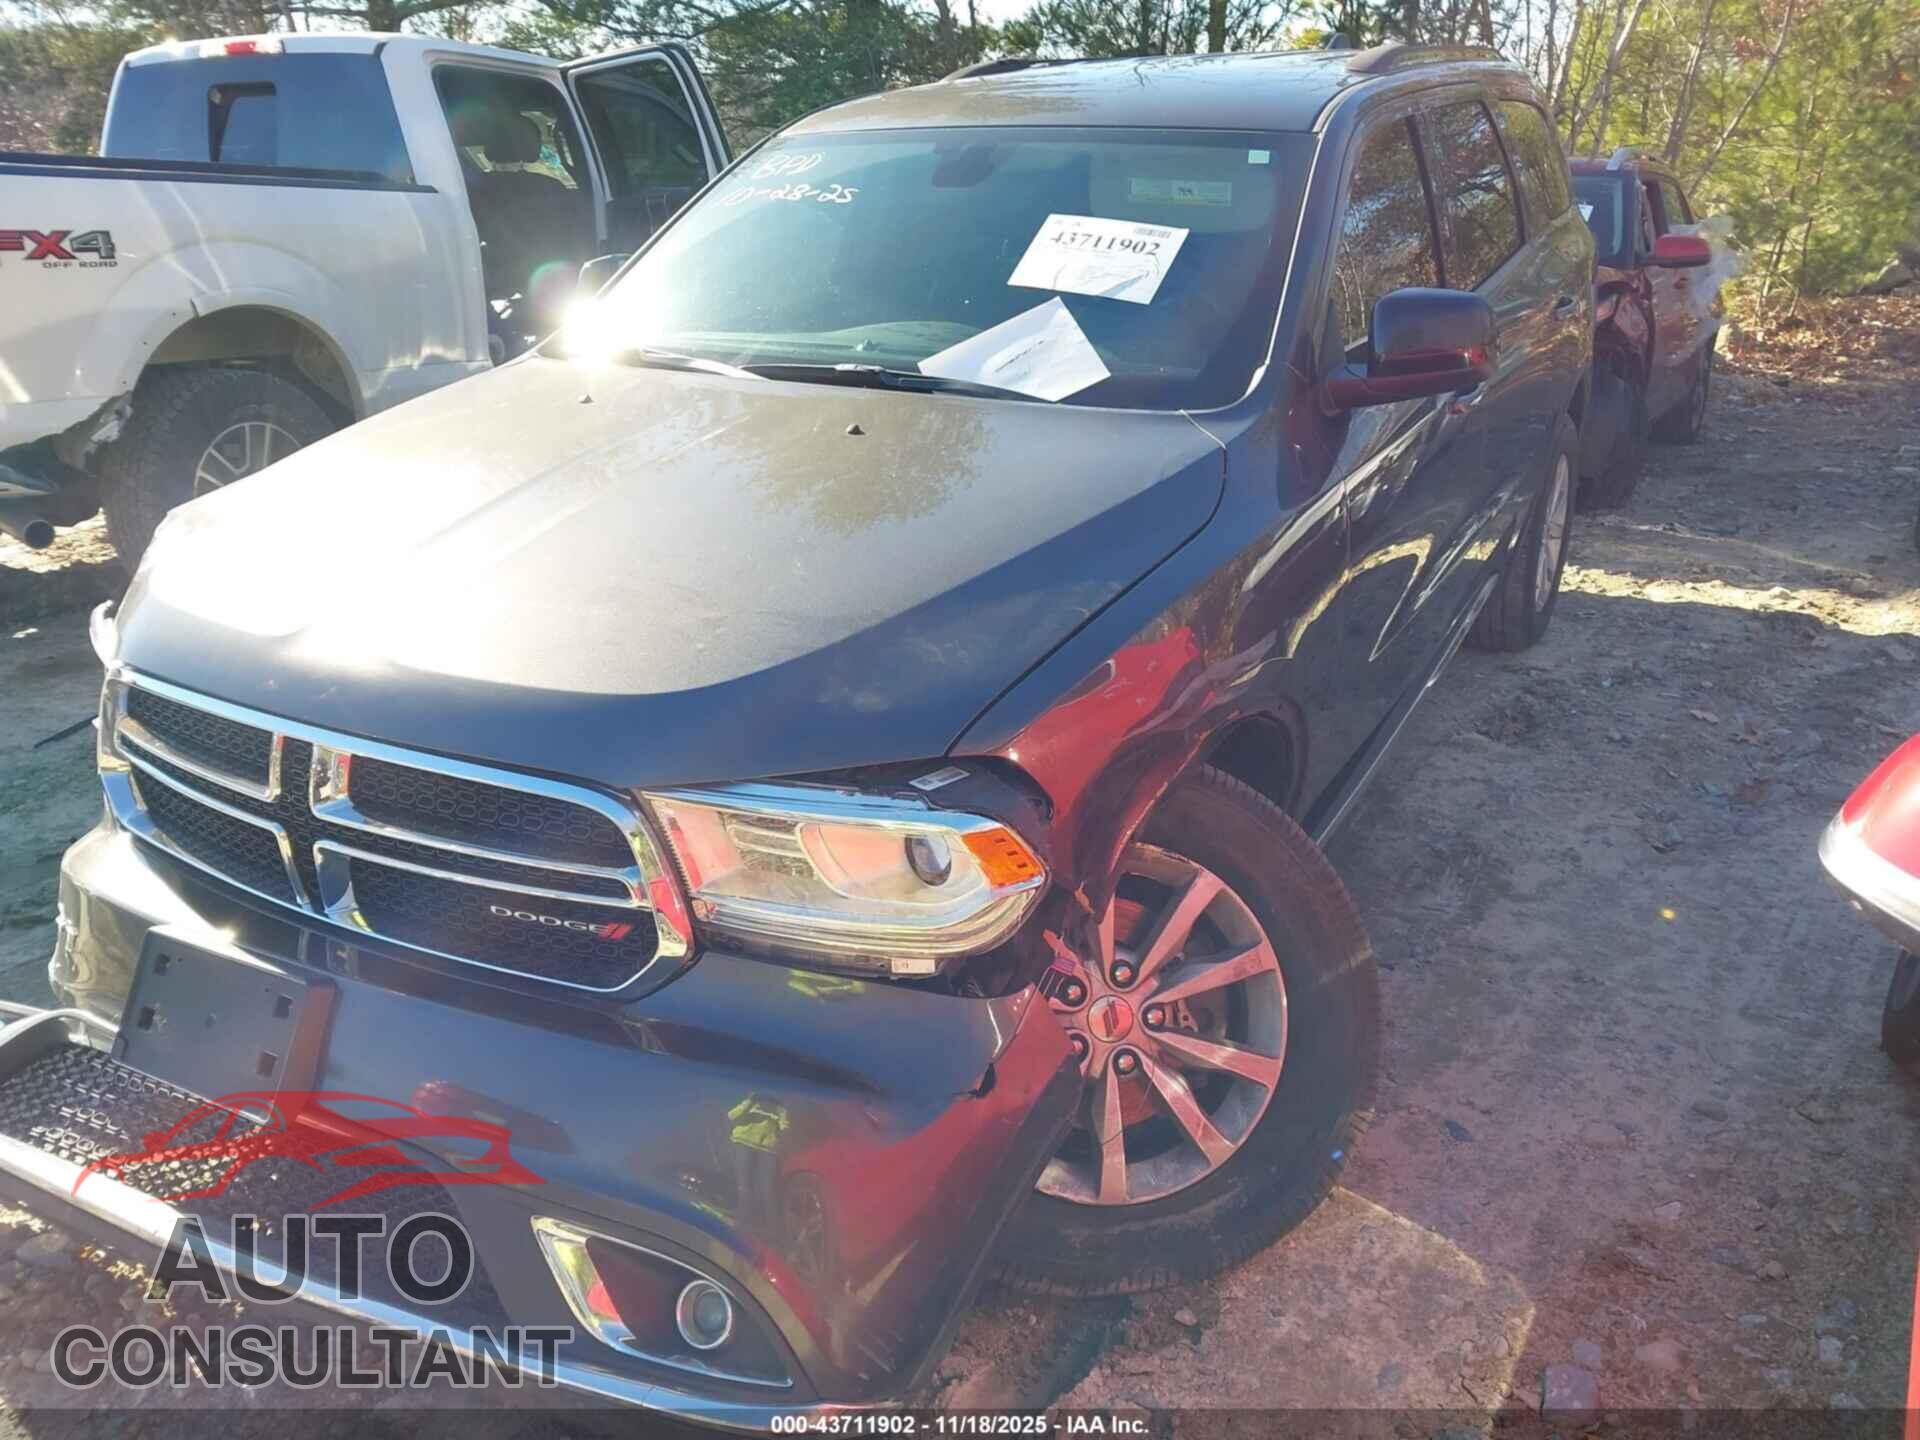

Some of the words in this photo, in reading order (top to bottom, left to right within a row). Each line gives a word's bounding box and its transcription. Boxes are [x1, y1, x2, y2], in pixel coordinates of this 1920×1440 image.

[1052, 230, 1161, 257] 43711902
[42, 261, 73, 269] OFF
[489, 904, 612, 935] DODGE
